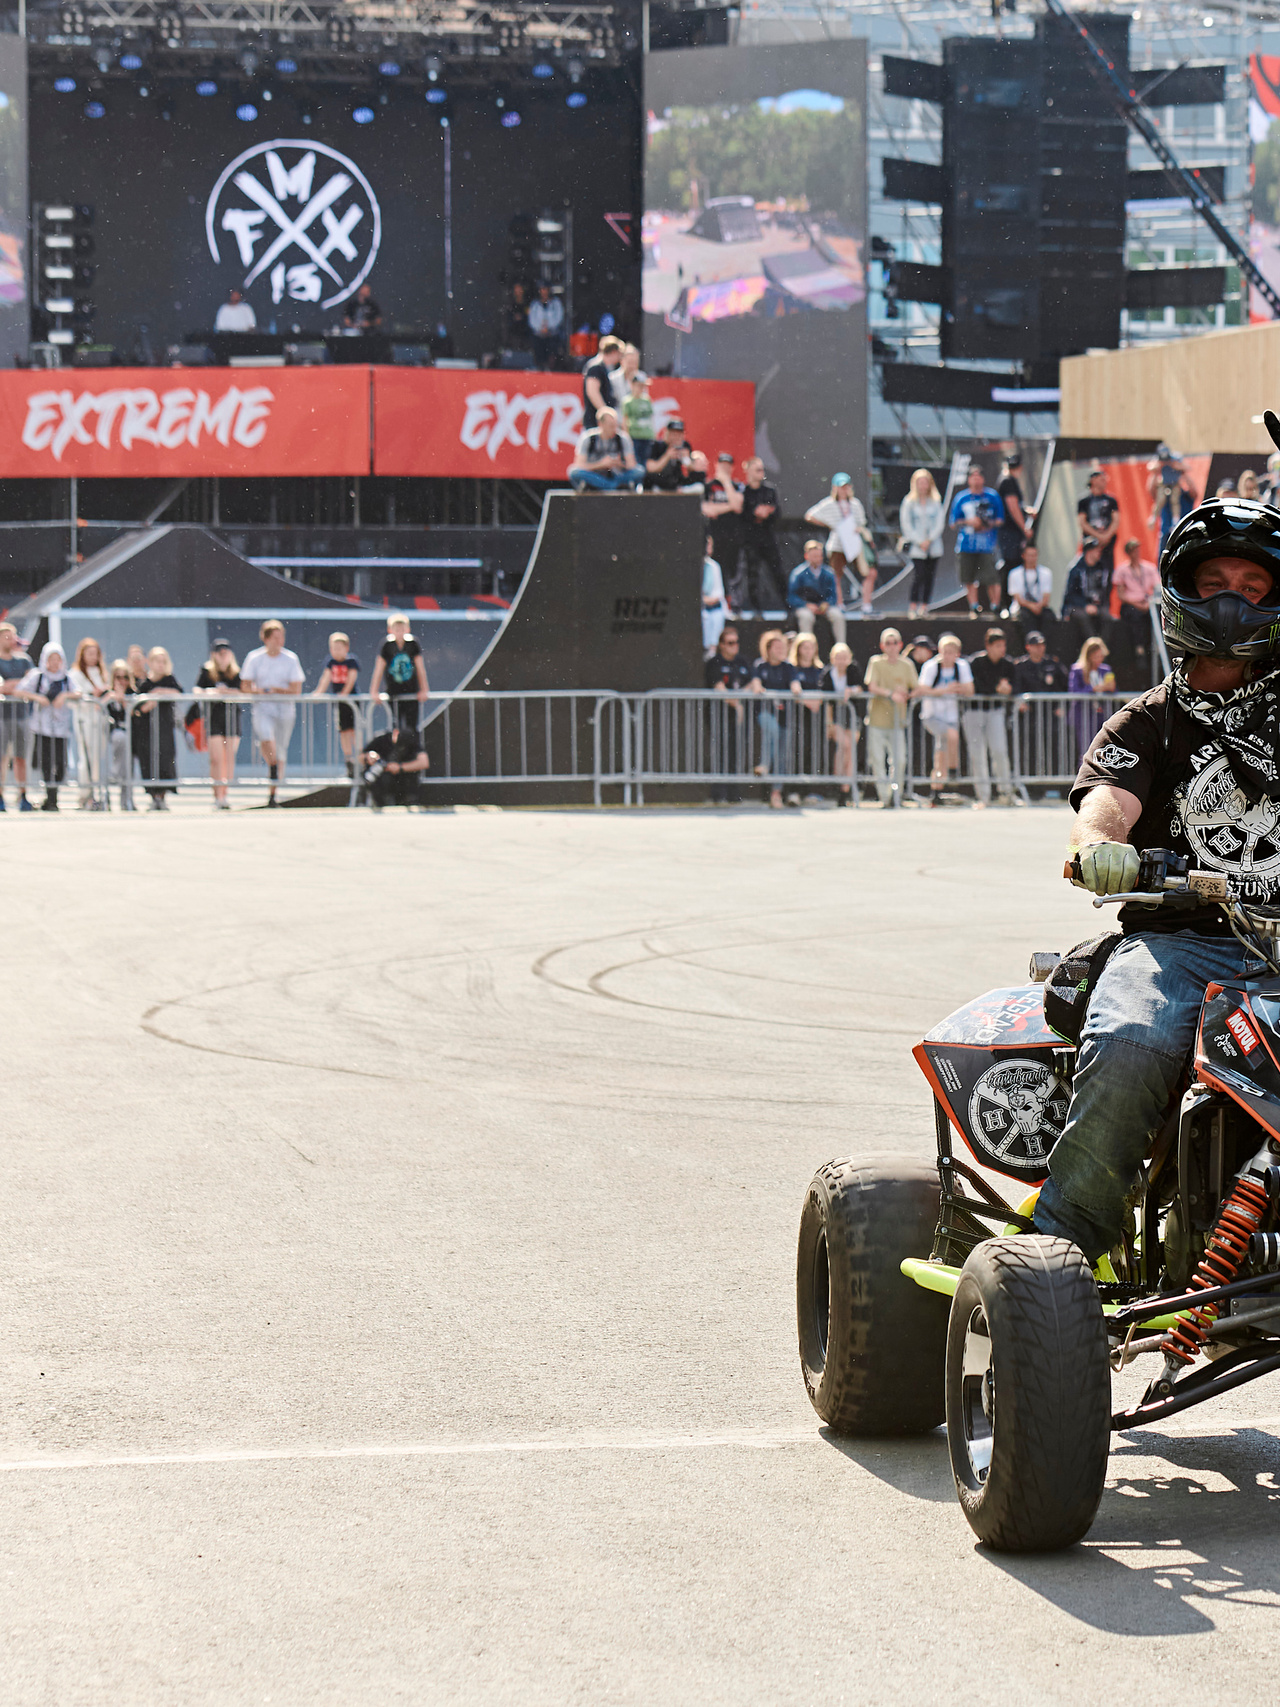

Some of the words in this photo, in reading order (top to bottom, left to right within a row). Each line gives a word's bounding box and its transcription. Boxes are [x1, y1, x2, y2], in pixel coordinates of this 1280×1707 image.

[22, 386, 275, 462] EXTREME
[459, 391, 681, 461] EXTRE
[614, 597, 669, 618] RCC
[1227, 1012, 1257, 1052] MOTUL
[981, 1108, 1008, 1132] H
[1022, 1134, 1046, 1157] H
